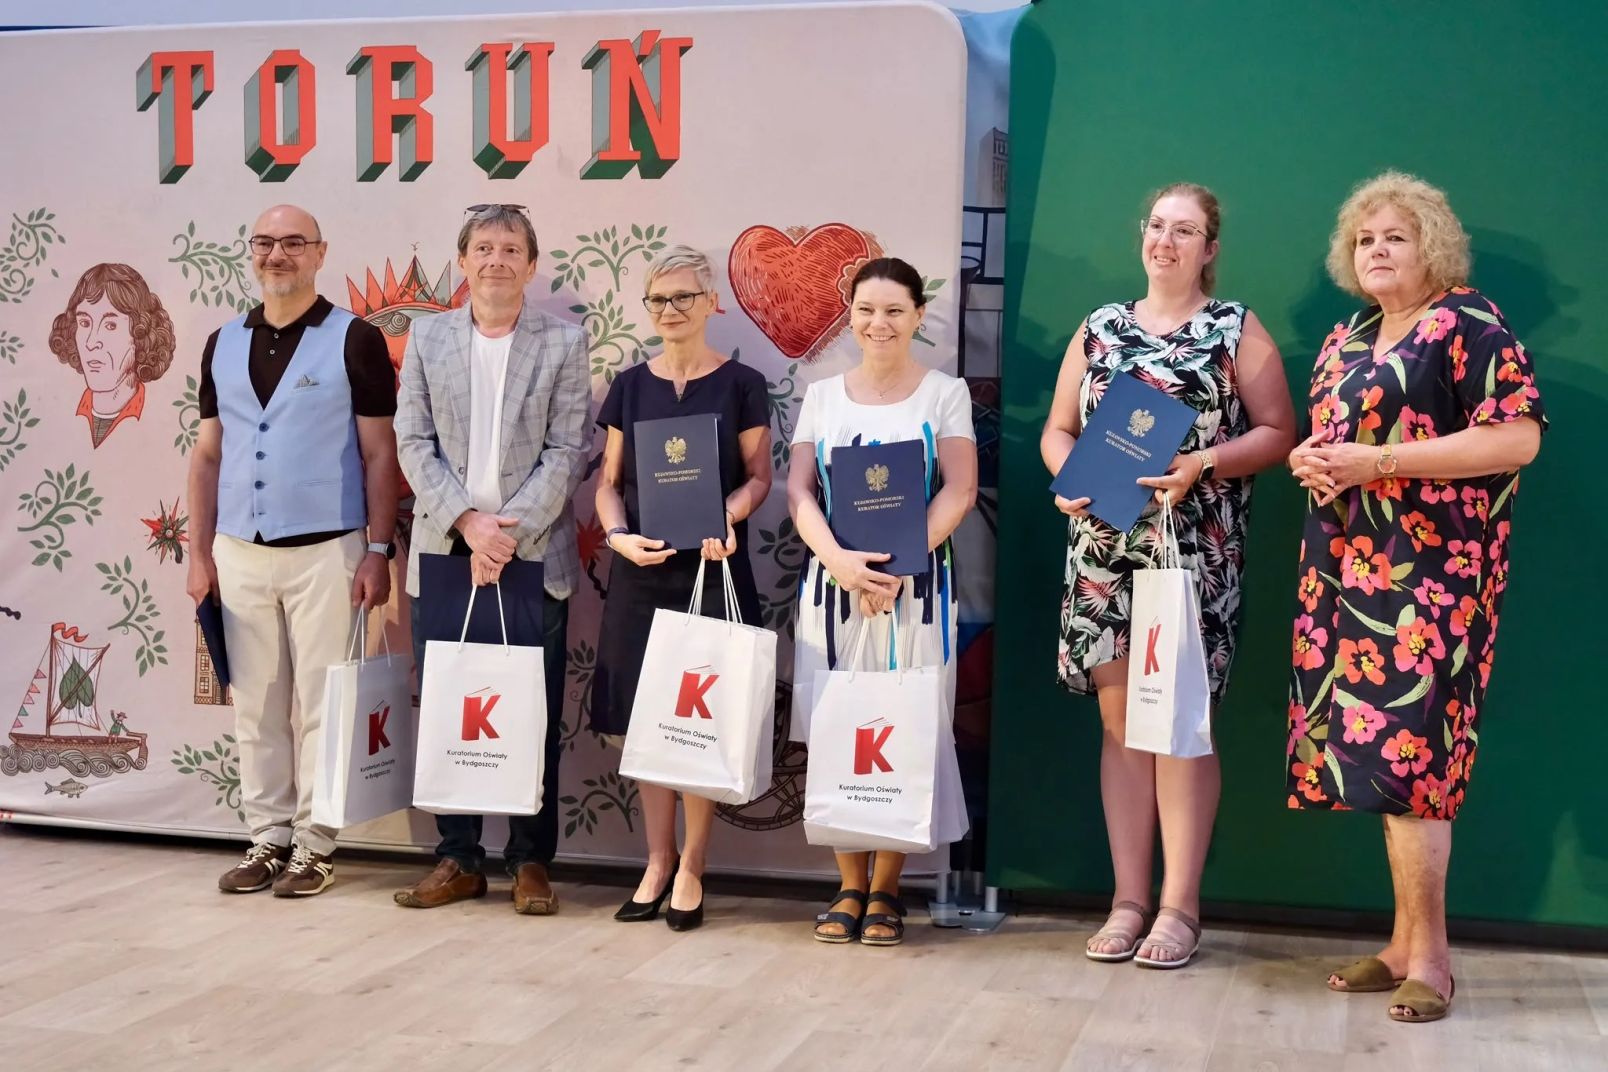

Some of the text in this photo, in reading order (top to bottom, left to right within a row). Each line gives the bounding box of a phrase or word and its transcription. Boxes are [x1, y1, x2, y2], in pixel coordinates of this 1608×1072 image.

[136, 29, 693, 184] TORUŃ
[1144, 624, 1162, 676] K
[674, 671, 720, 719] K
[368, 705, 391, 756] K
[462, 694, 502, 741] K
[658, 722, 718, 743] Kuratorium Oświaty
[446, 749, 508, 760] Kuratorium Oświaty
[670, 735, 707, 750] Bydgoszczy
[854, 725, 895, 775] K
[462, 759, 499, 768] Bydgoszczy
[838, 784, 903, 795] Kuratorium Oświaty
[854, 794, 893, 804] Bydgoszczy
